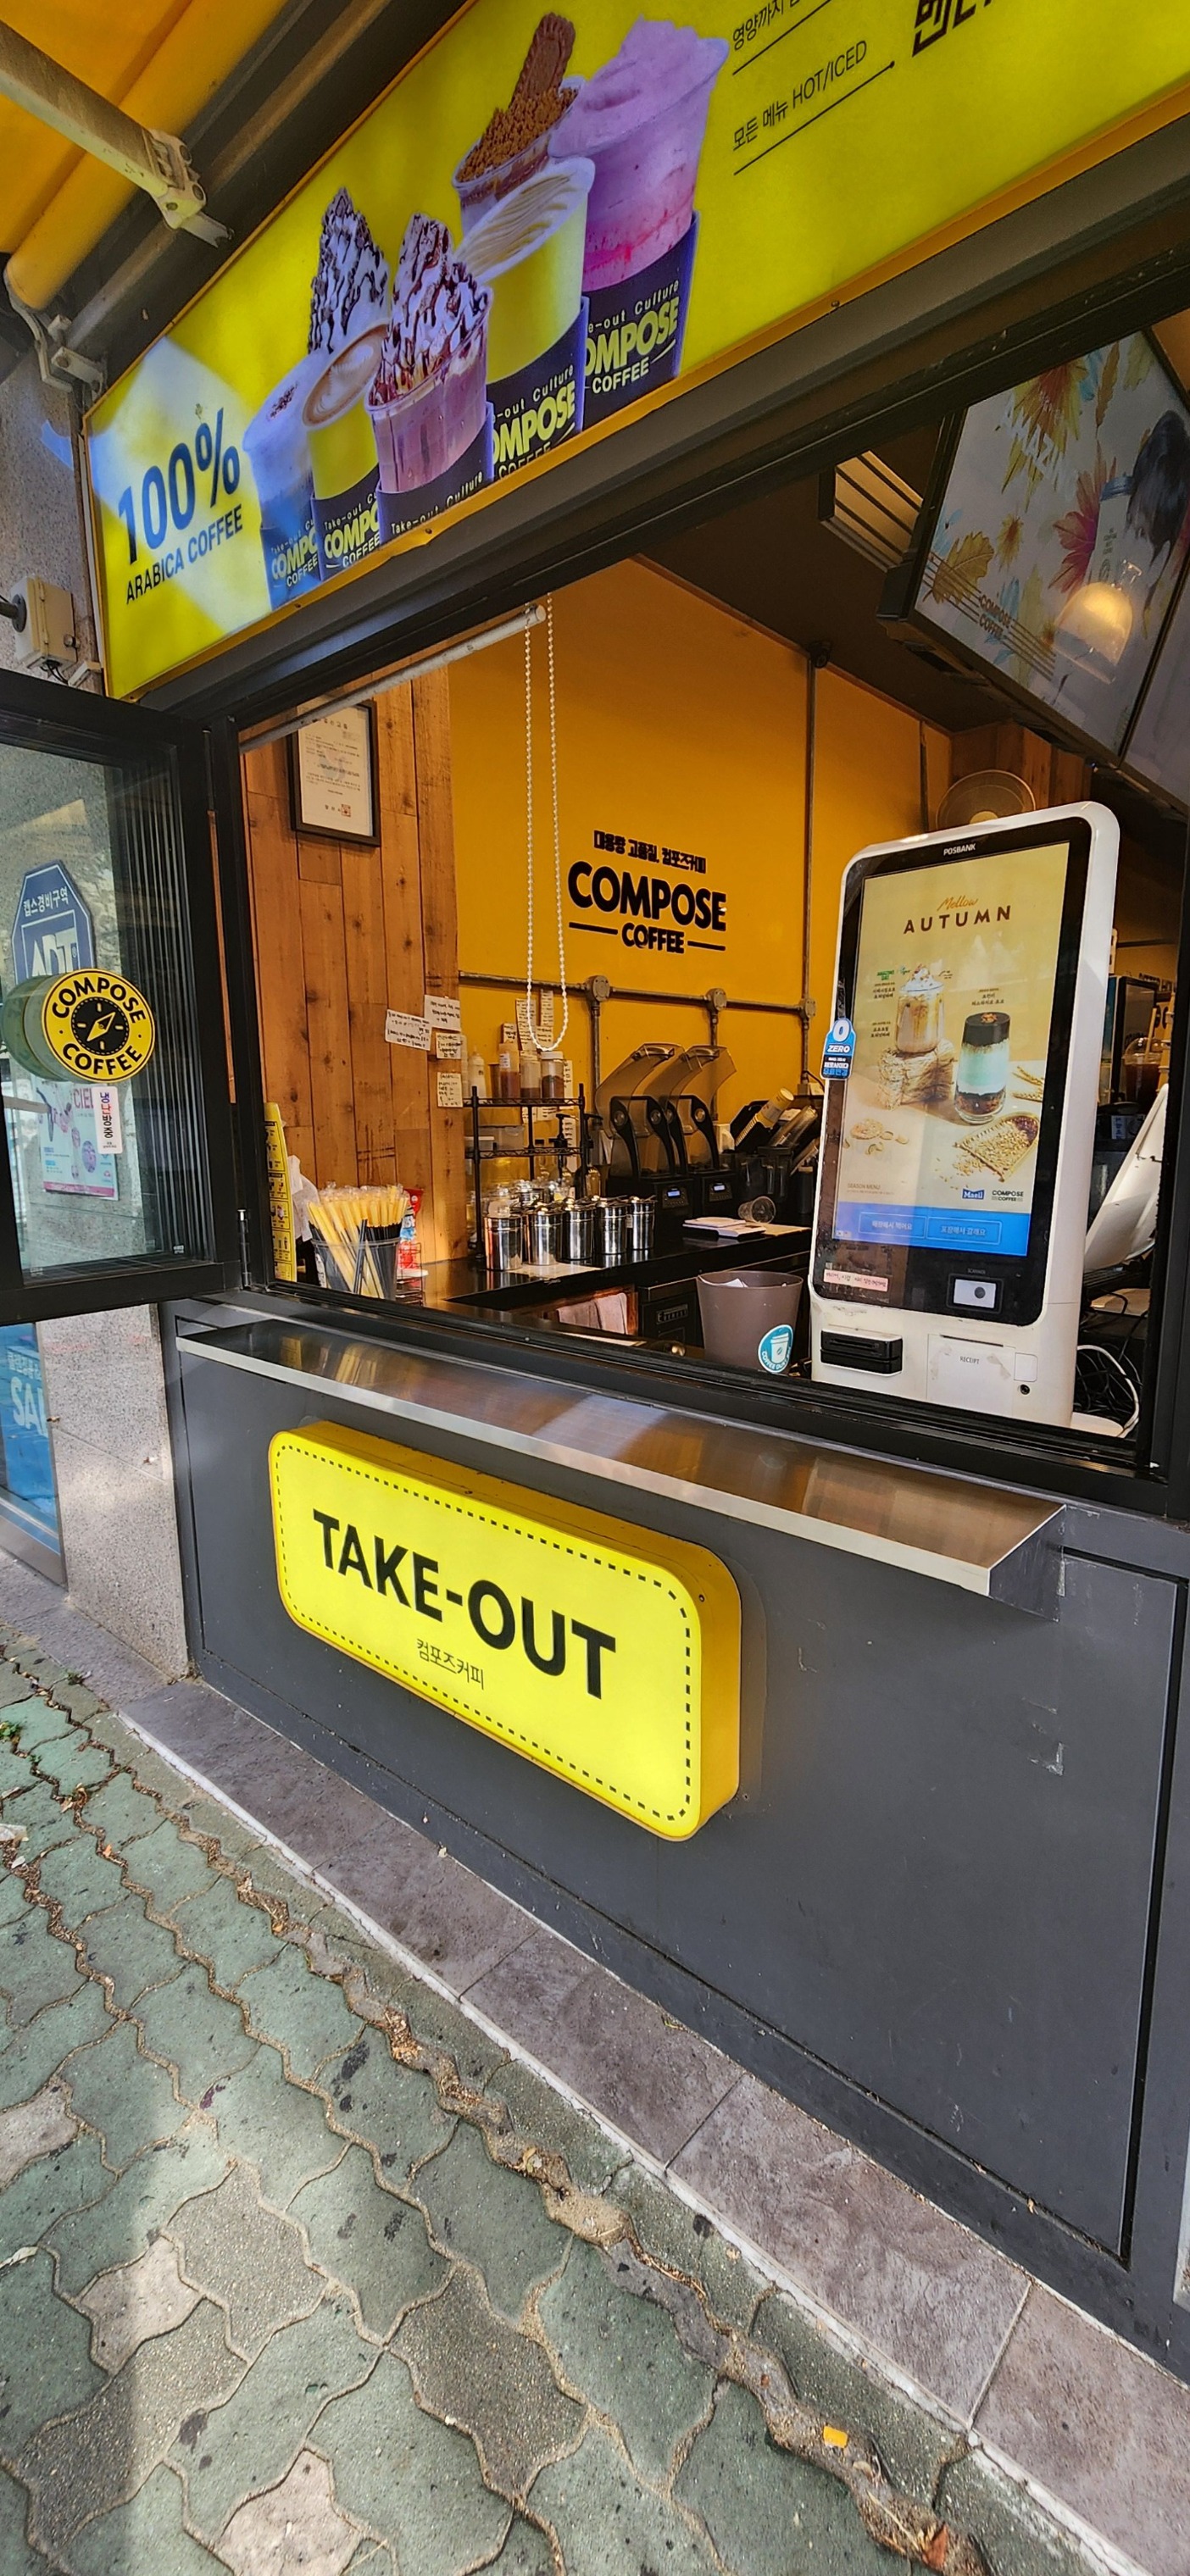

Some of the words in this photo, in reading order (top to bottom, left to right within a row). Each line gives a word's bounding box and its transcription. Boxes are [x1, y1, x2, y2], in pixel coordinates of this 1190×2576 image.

[732, 117, 759, 152] 모든
[762, 101, 789, 127] 메뉴
[792, 40, 867, 109] HOT/ICED
[634, 280, 679, 315] Culture
[533, 364, 574, 402] Culture
[592, 357, 649, 394] COFFEE
[118, 408, 241, 565] 100%
[447, 471, 483, 508] Culture
[324, 502, 362, 530] Take-out
[126, 547, 185, 605] ARABICA
[188, 504, 243, 564] COFFEE
[342, 531, 380, 568] COFFEE
[286, 554, 318, 587] COFFEE
[661, 847, 707, 874] 컴포즈커피
[943, 843, 976, 856] POSBANK
[24, 886, 69, 917] 캡스경비구역
[567, 861, 727, 932] COMPOSE
[937, 895, 979, 912] Mellow
[621, 922, 685, 954] COFFEE
[904, 905, 1011, 935] AUTUMN
[31, 927, 77, 977] ADT
[52, 977, 147, 1024] COMPOSE
[62, 1043, 143, 1075] COFFEE
[826, 1044, 850, 1053] ZERO
[959, 1356, 980, 1364] RECEIPT
[313, 1508, 616, 1700] TAKE-OUT
[416, 1638, 484, 1690] 컴포즈커피
